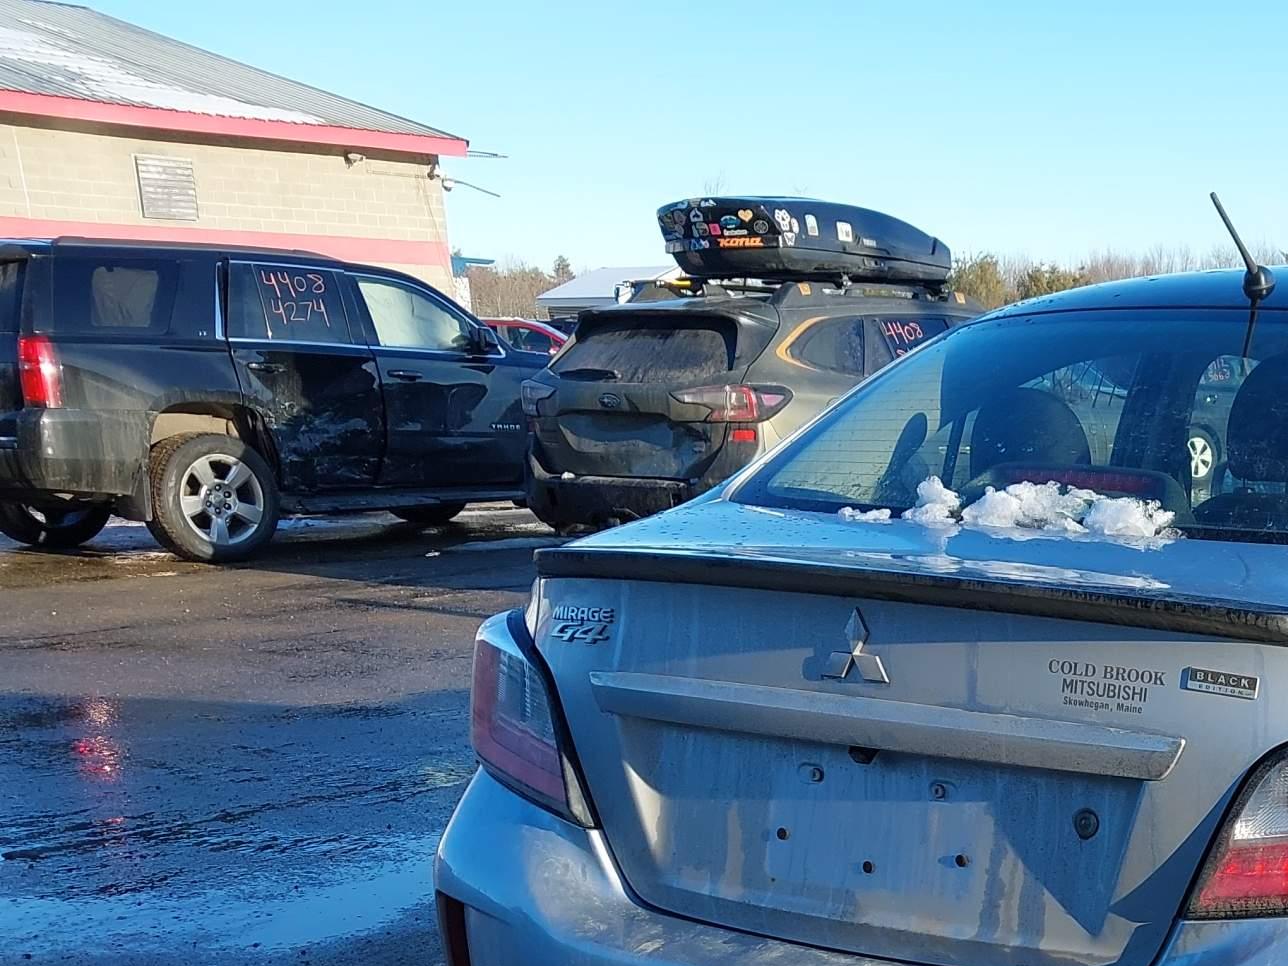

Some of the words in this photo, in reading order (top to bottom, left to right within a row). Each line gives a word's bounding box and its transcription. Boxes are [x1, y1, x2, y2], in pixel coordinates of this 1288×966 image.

[261, 270, 325, 298] 4408
[270, 298, 330, 328] 4274
[881, 320, 924, 345] 4408
[552, 605, 615, 623] MIRAGE
[551, 622, 610, 645] G4
[1048, 658, 1097, 678] COLD
[1102, 664, 1167, 687] BROOK
[1196, 671, 1249, 688] BLACK
[1061, 677, 1148, 703] MITSUBISHI
[1063, 696, 1113, 713] Skowhegan,
[1116, 702, 1143, 714] Maine
